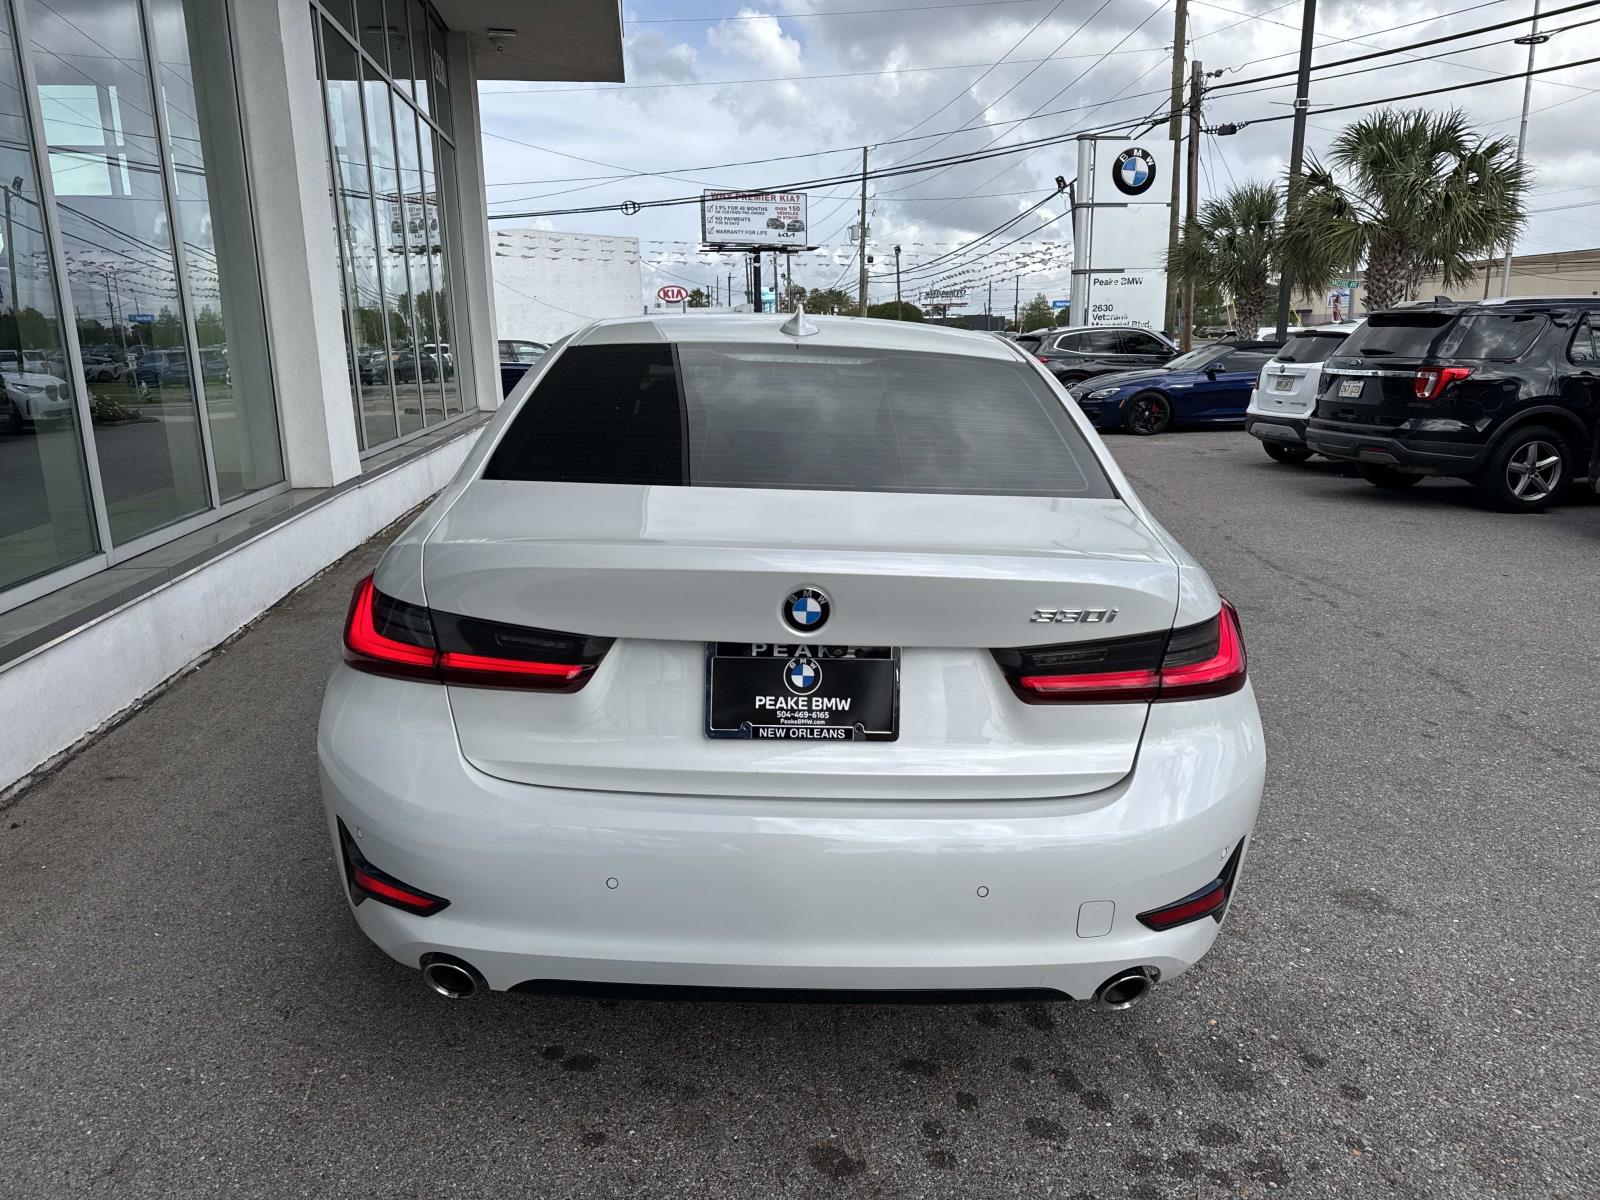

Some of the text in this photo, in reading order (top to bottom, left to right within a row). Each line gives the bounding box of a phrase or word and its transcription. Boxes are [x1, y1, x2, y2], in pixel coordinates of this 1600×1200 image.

[1119, 149, 1154, 166] BMW
[780, 194, 801, 203] KIA?
[663, 289, 684, 299] KIA
[1092, 304, 1114, 313] 2630
[789, 589, 829, 605] BMW
[1029, 607, 1120, 623] 330i
[751, 643, 856, 659] PEAK
[789, 658, 818, 670] BMW
[755, 695, 852, 711] PEAKE BMW
[776, 710, 830, 719] 504-469-6165
[780, 718, 826, 726] PeakeBMW.com
[759, 728, 846, 739] NEW ORLEANS
